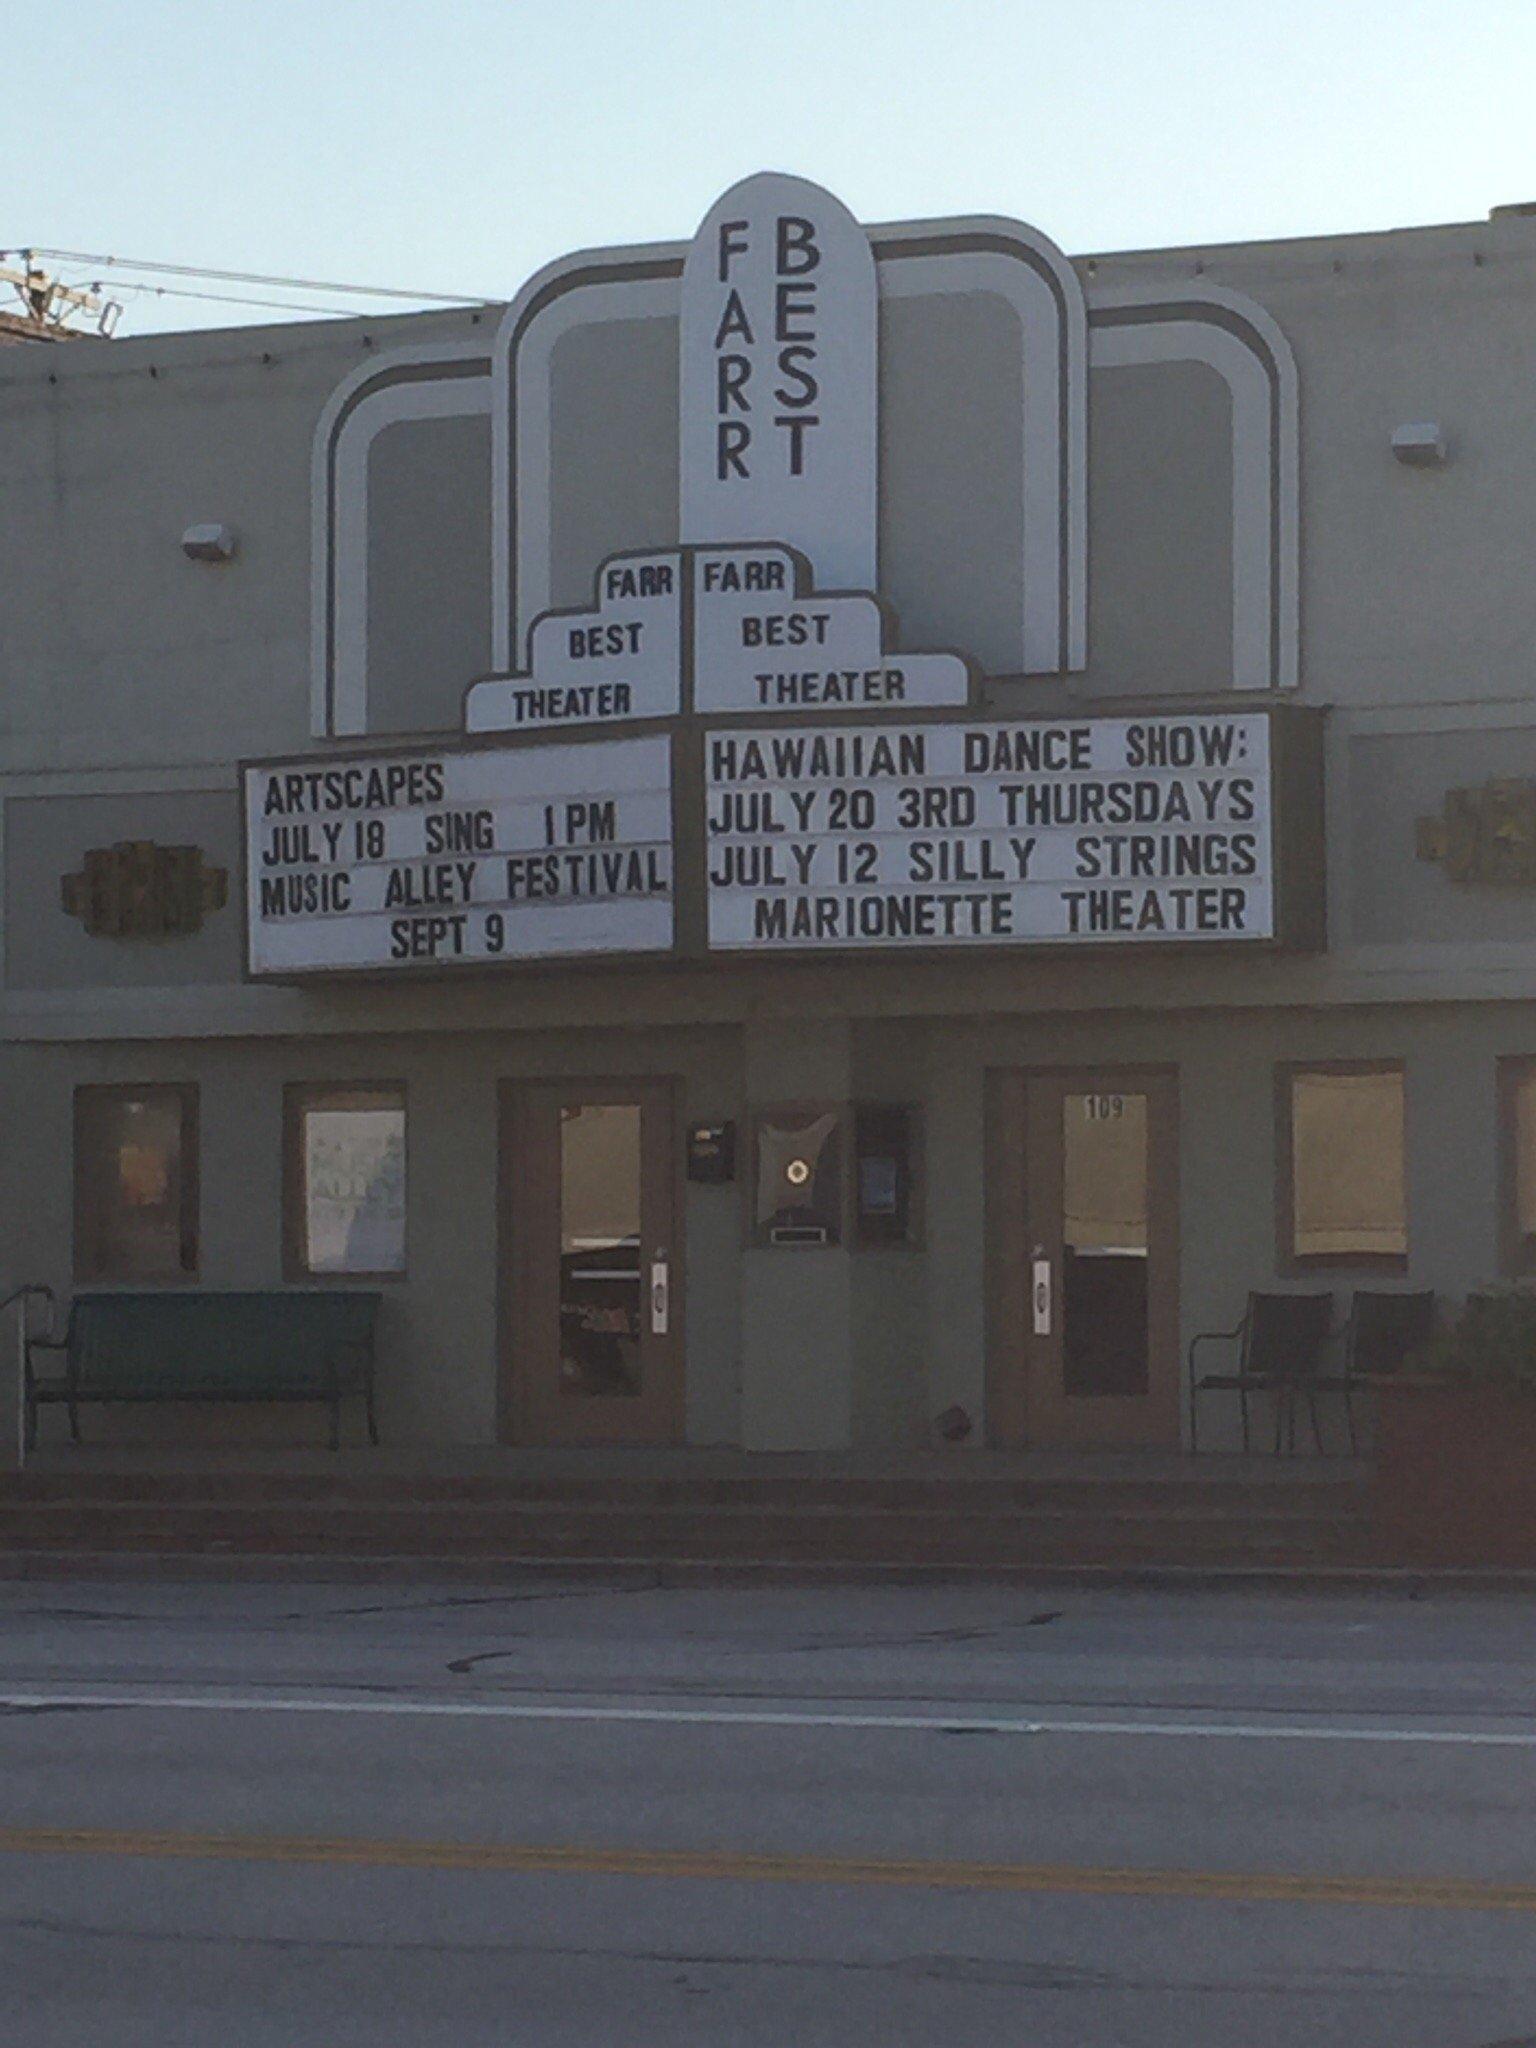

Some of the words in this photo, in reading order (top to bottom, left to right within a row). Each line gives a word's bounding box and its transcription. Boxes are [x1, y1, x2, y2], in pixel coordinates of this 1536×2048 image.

[715, 220, 755, 481] FARR
[773, 216, 821, 476] BEST
[606, 564, 673, 599] FARR
[703, 560, 785, 594] FARR
[568, 622, 643, 658] BEST
[742, 614, 830, 647] BEST
[512, 683, 632, 722] THEATER
[755, 670, 905, 704] THEATER
[712, 735, 925, 781] HAWAIIAN
[964, 728, 1092, 773] DANCE
[264, 763, 445, 816] ARTSCAPES
[709, 792, 817, 834] JULY
[828, 788, 875, 831] 20
[897, 785, 976, 828] 3RD
[999, 779, 1255, 826] THURSDAYS
[262, 822, 342, 866] JULY
[355, 820, 386, 859] 18
[425, 809, 494, 855] SING
[545, 804, 555, 846] 1
[566, 801, 616, 844] PM
[260, 872, 351, 916] MUSIC
[384, 861, 477, 909] ALLEY
[507, 849, 668, 900] FESTIVAL
[709, 844, 817, 887] JULY
[837, 842, 878, 884] 12
[909, 837, 1037, 882] SILLY
[1075, 835, 1257, 879] STRINGS
[391, 915, 468, 958] SEPT
[485, 913, 505, 952] 9
[754, 892, 1013, 938] MARIONETTE
[1060, 888, 1247, 933] THEATER
[1086, 1096, 1124, 1119] 109
